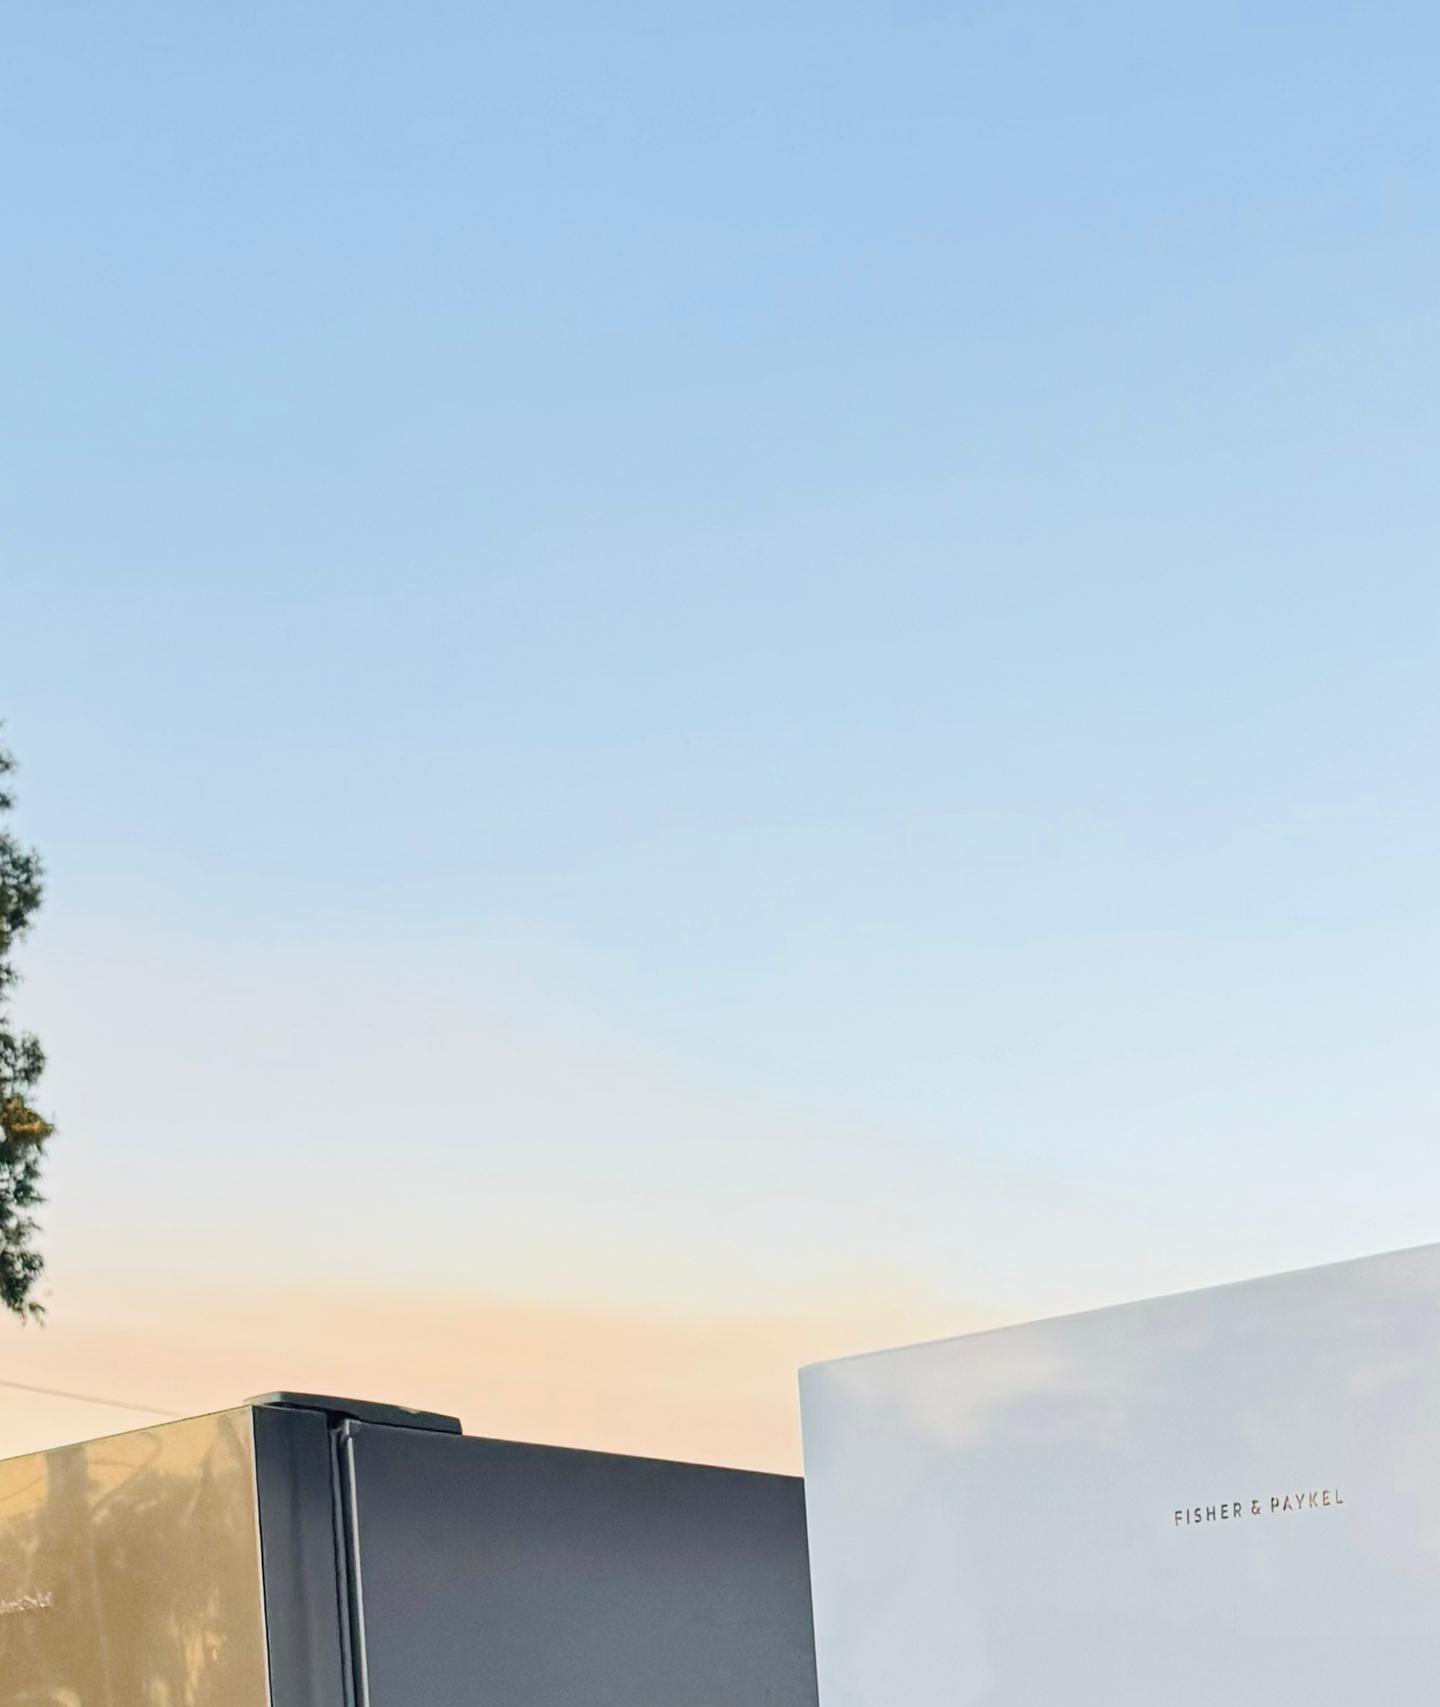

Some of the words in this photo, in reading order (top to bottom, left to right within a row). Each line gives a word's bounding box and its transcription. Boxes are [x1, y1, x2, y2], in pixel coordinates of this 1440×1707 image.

[1174, 1501, 1242, 1526] FISHER
[1251, 1499, 1261, 1516] &
[1270, 1489, 1344, 1513] PAYKEL
